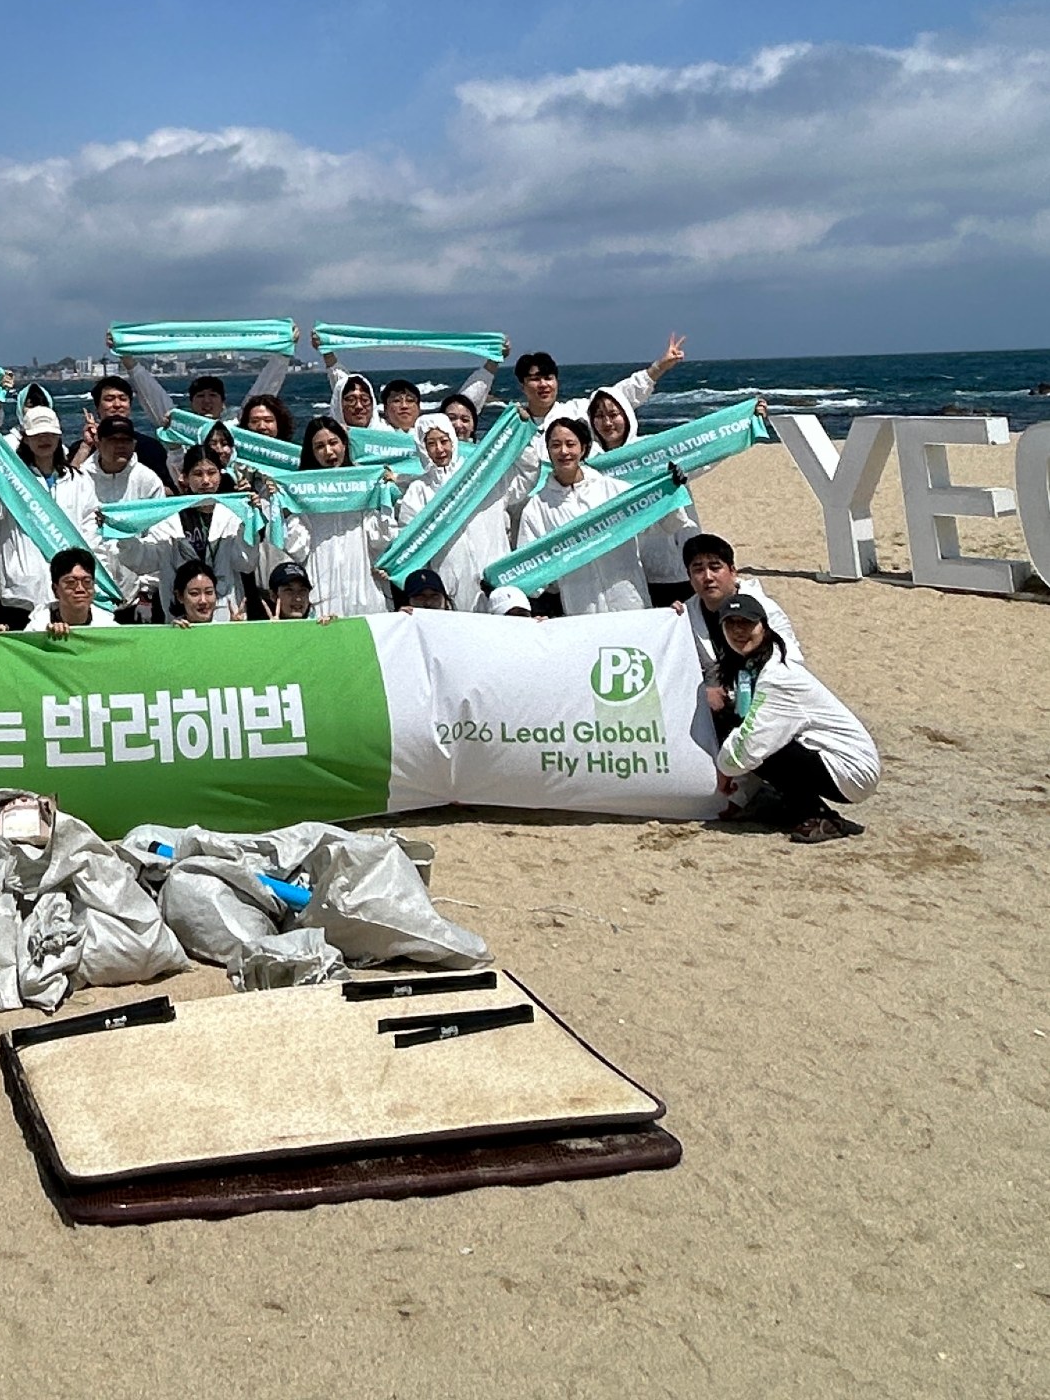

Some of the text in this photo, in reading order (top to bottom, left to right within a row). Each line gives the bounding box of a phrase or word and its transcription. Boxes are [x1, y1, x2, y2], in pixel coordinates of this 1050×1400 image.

[641, 449, 667, 466] OUR
[668, 429, 718, 457] NATURE
[289, 483, 317, 495] OUR
[318, 480, 368, 493] NATURE
[28, 500, 52, 525] OUR
[551, 538, 580, 557] OUR
[579, 510, 628, 543] NATURE
[627, 488, 664, 517] STORY
[42, 683, 309, 767] 반려해변
[436, 720, 666, 744] 2026 Lead Global,
[541, 752, 578, 775] Fly
